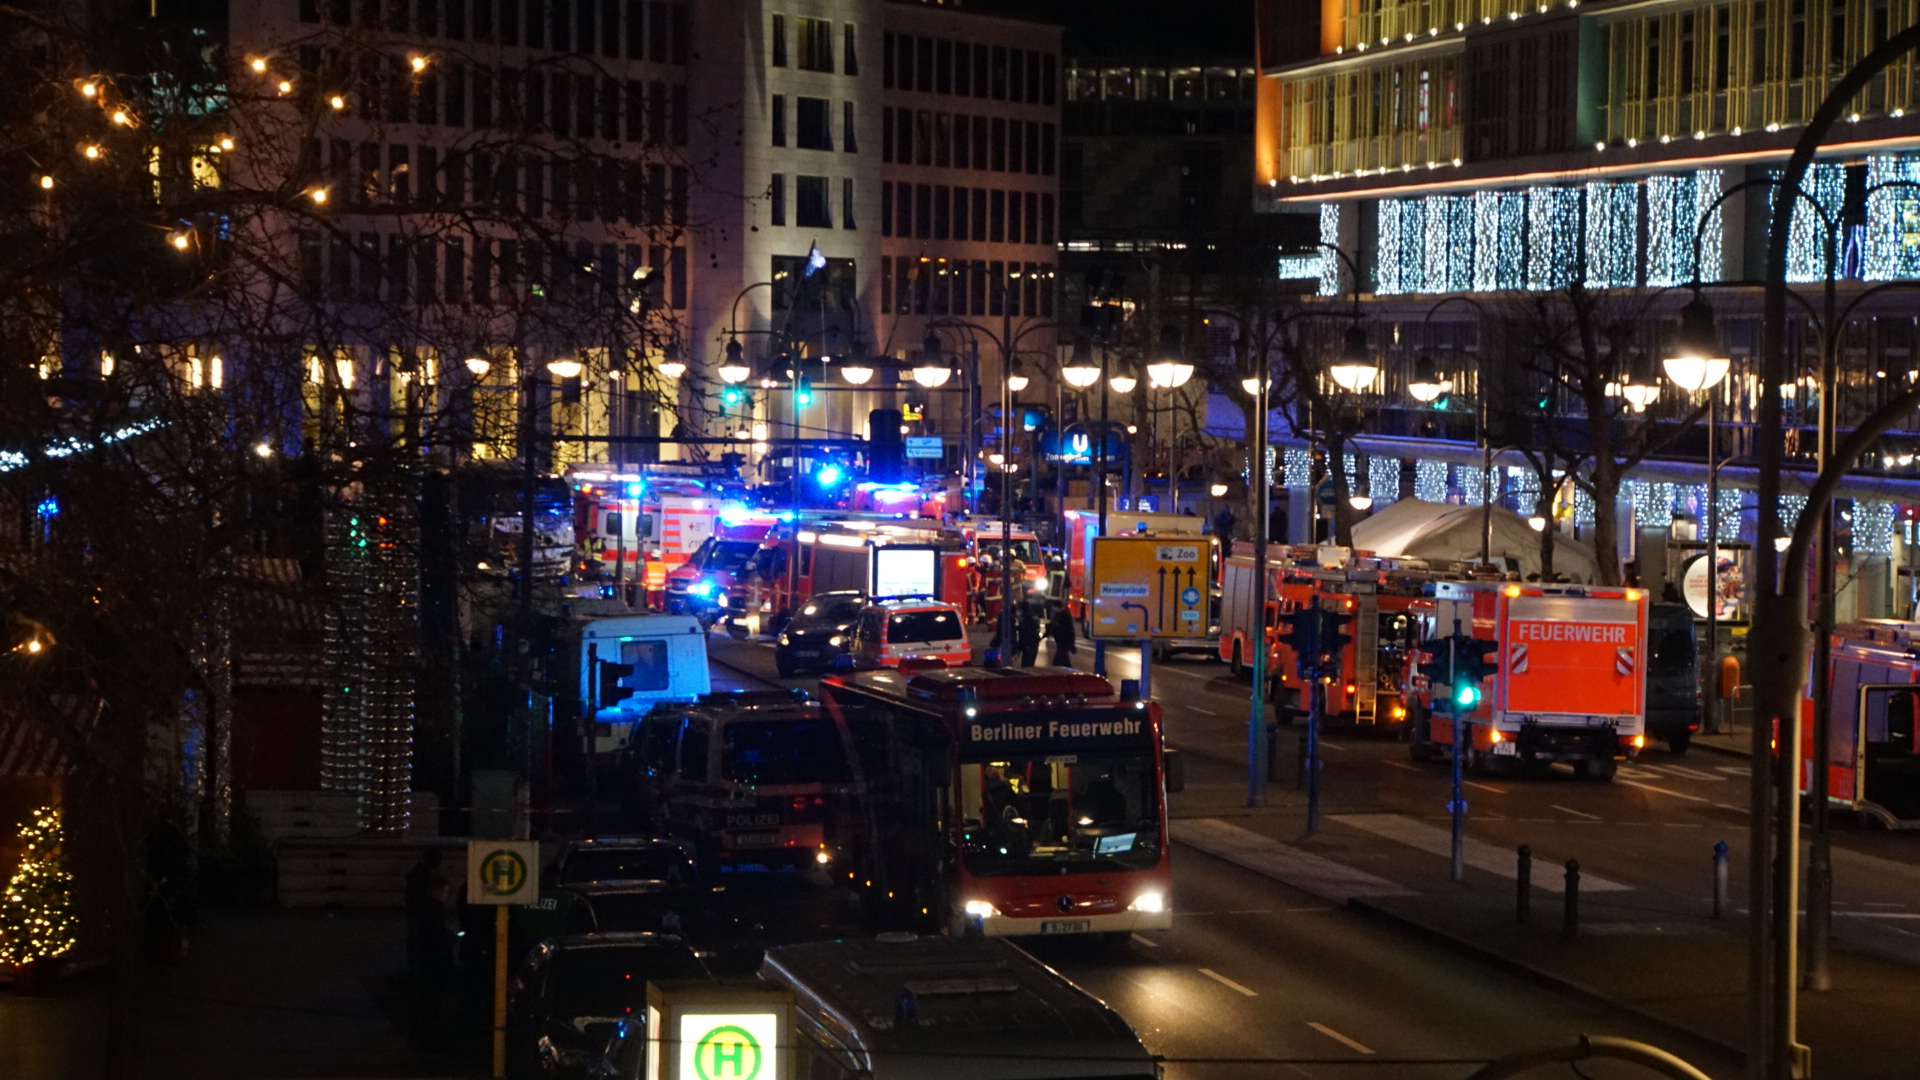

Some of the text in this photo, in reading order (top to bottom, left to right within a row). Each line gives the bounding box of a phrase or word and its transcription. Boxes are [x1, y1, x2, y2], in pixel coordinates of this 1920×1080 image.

[1072, 434, 1088, 452] U
[1177, 549, 1196, 559] Zoo
[1519, 623, 1626, 643] FEUERWEHR
[971, 717, 1142, 741] Berliner Feuerwehr
[726, 813, 780, 826] POLIZEI
[493, 860, 514, 885] H
[714, 1042, 743, 1076] H
